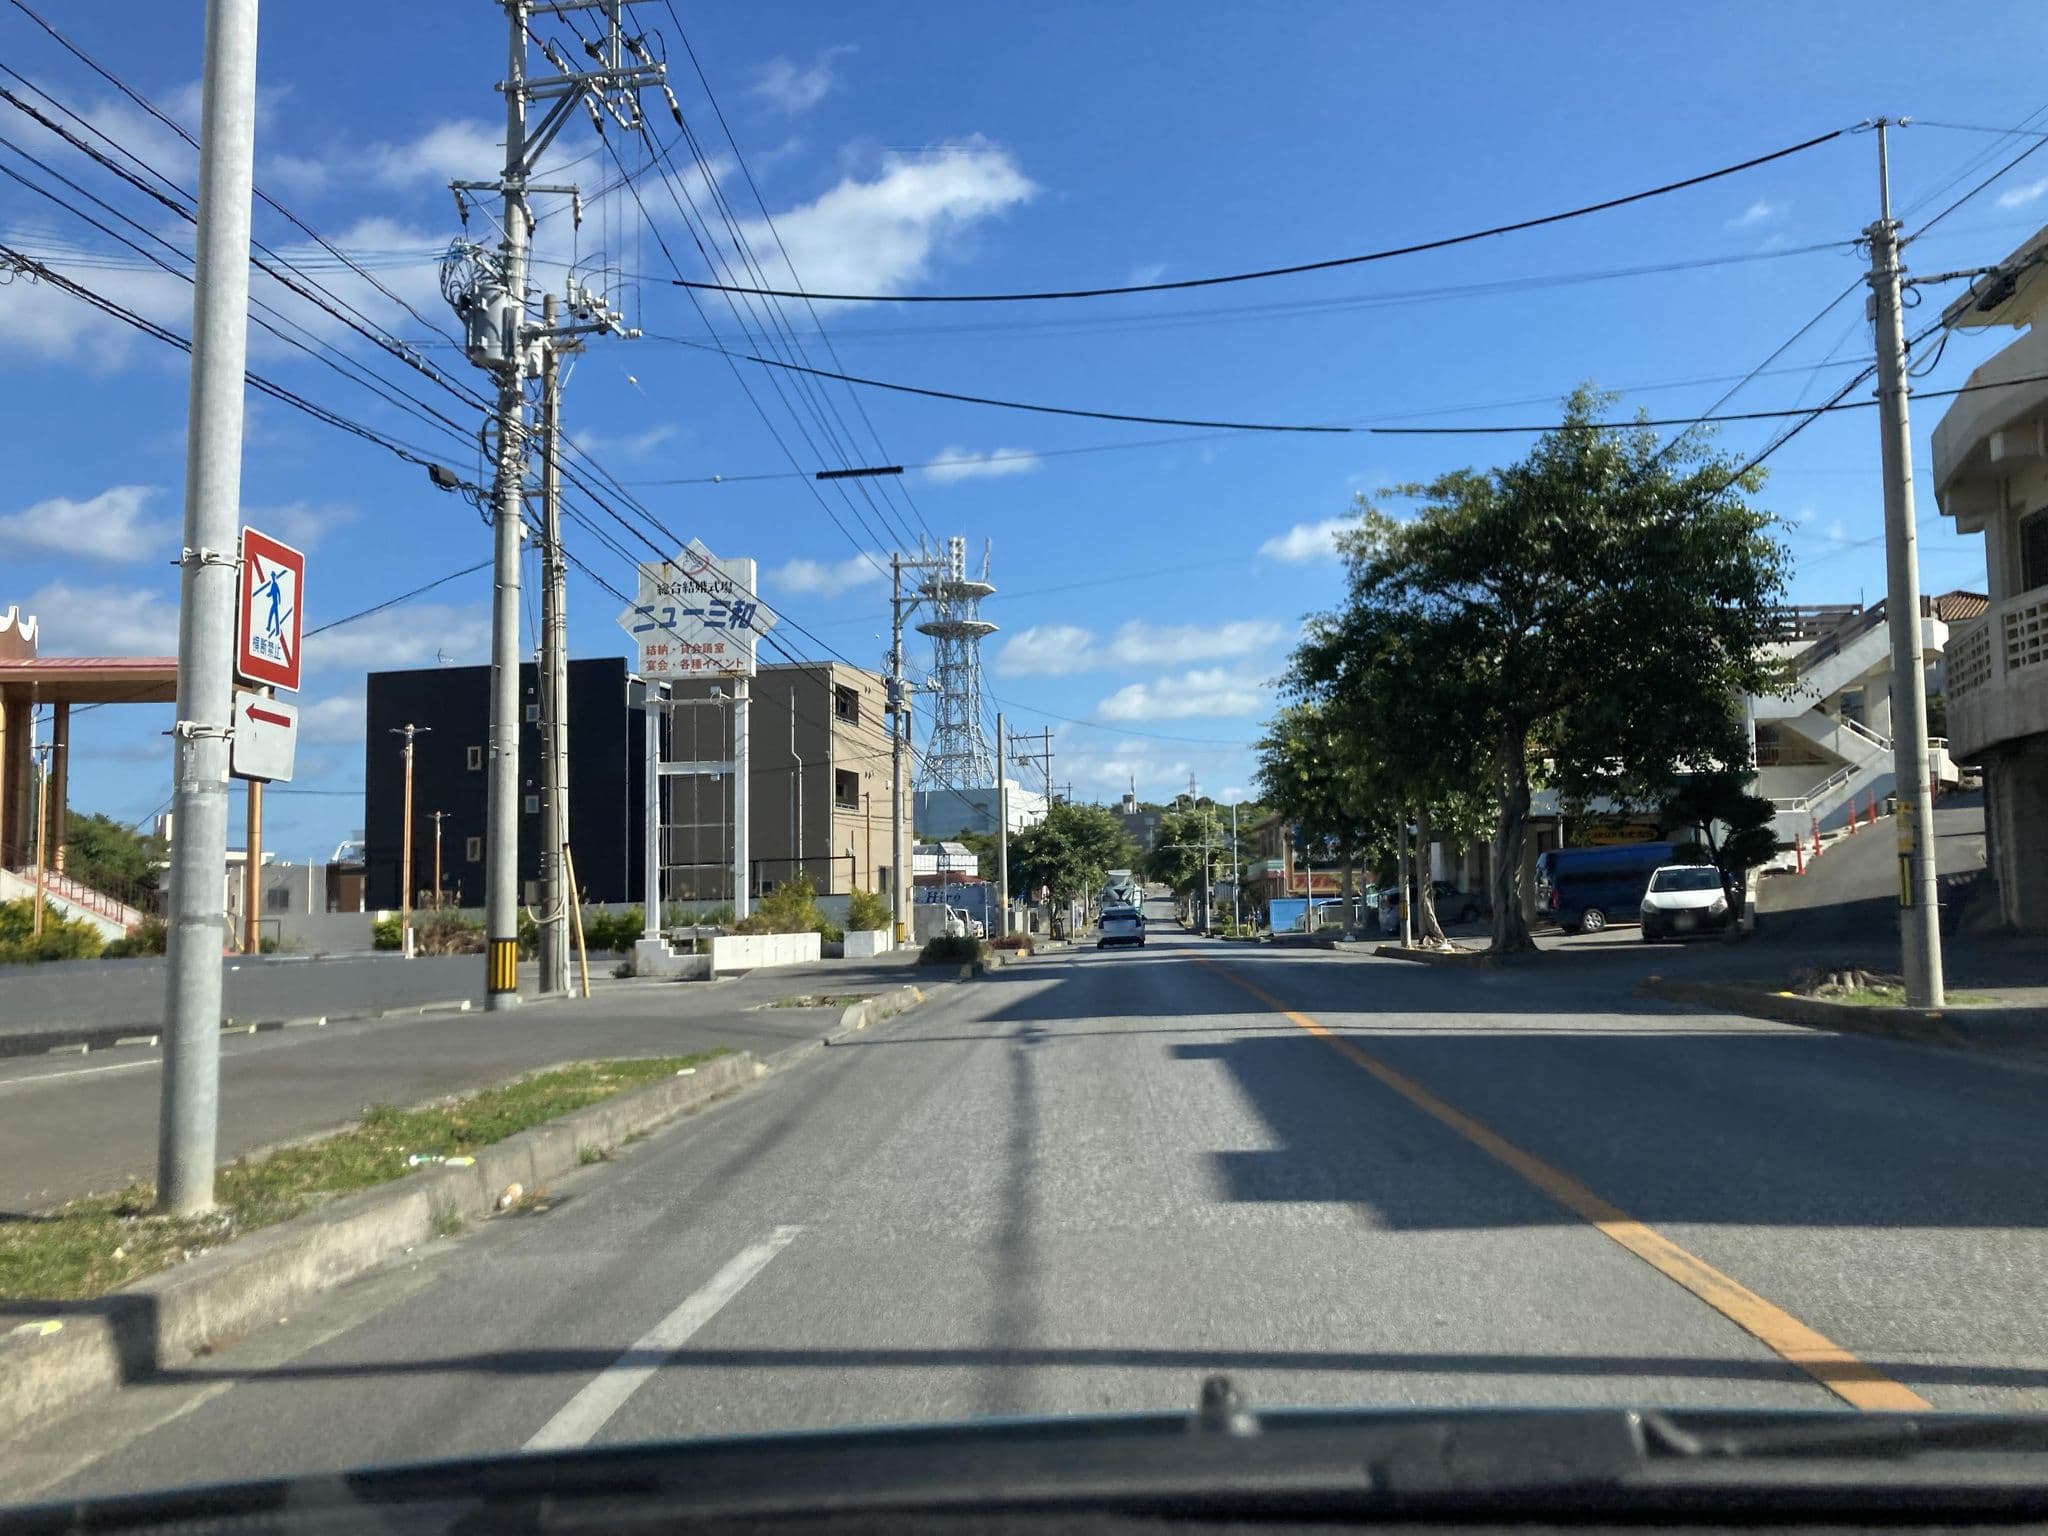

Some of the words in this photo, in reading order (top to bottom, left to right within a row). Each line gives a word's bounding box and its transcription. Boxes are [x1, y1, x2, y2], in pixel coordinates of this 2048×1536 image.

[633, 600, 757, 633] ニュー三和
[252, 636, 281, 660] 横断禁止
